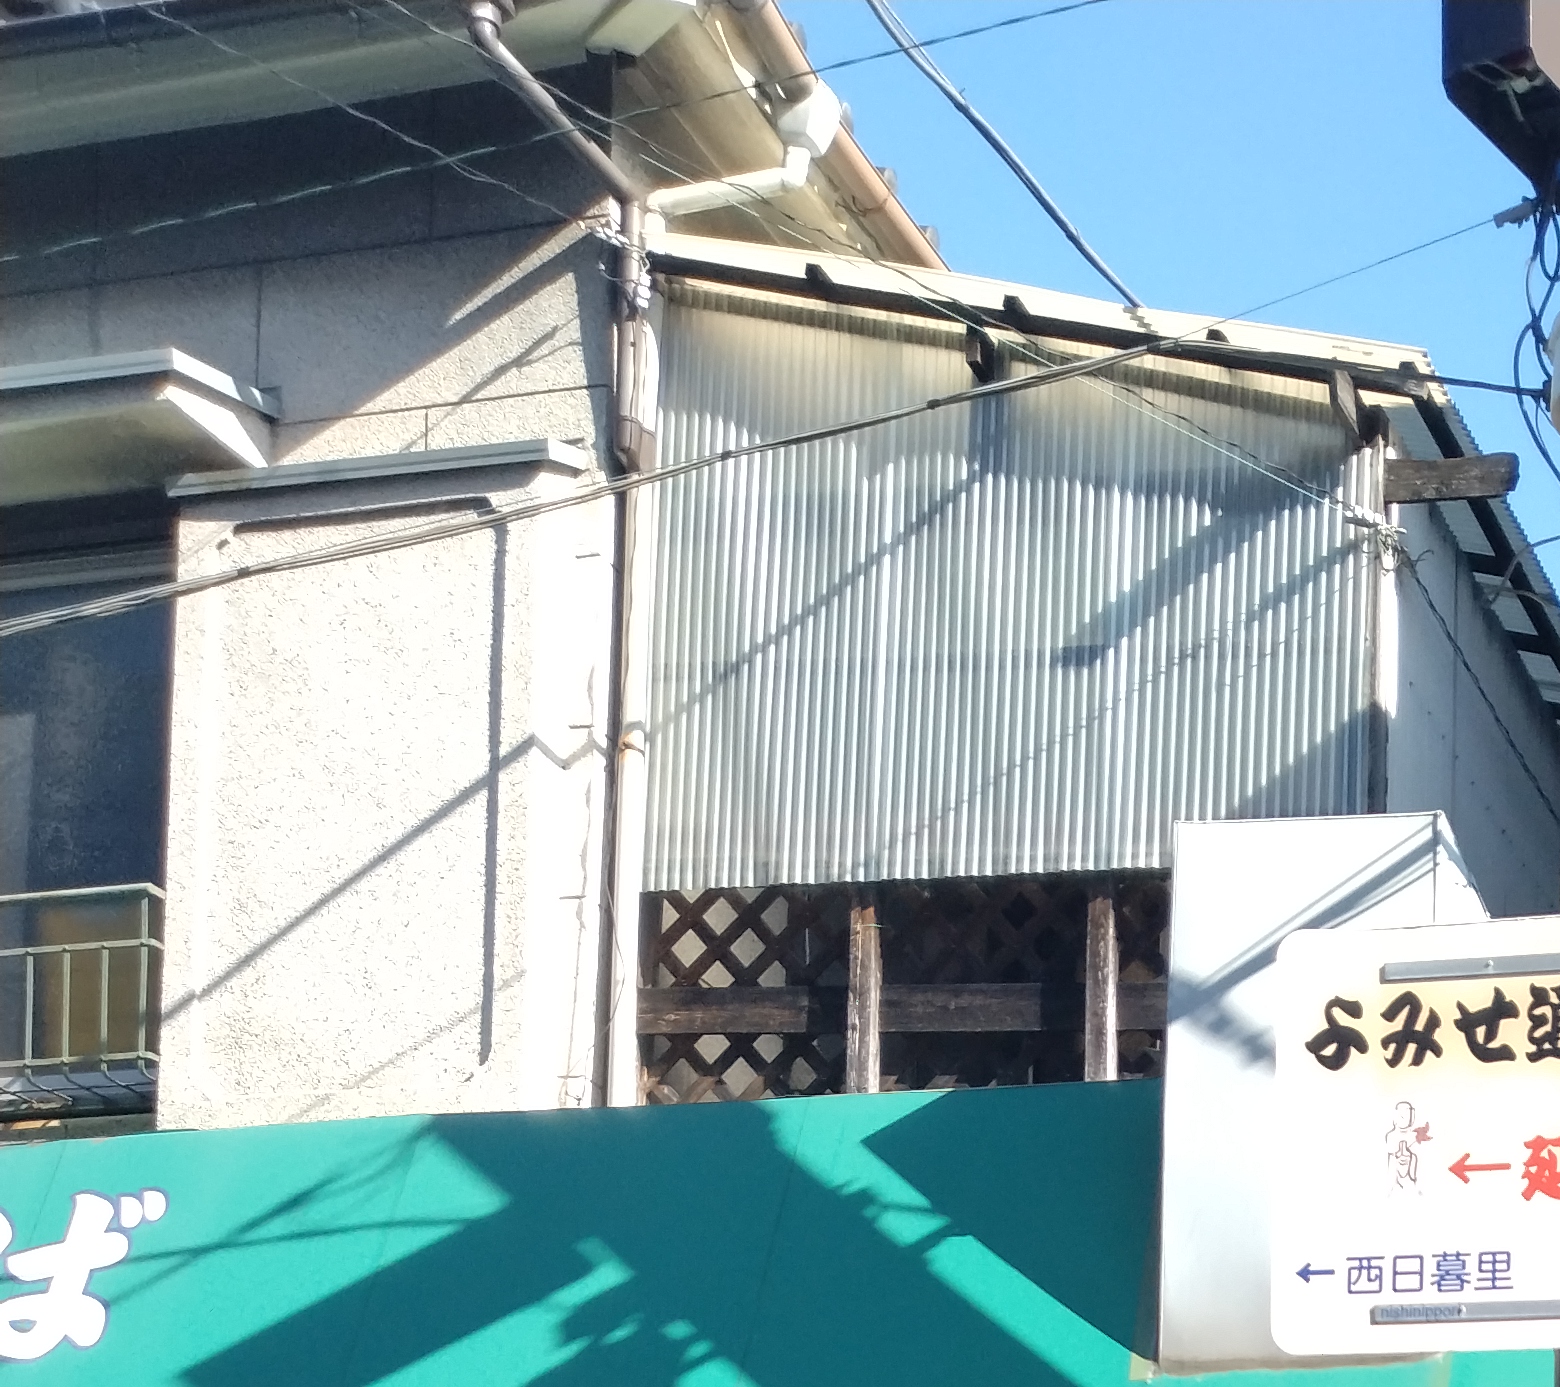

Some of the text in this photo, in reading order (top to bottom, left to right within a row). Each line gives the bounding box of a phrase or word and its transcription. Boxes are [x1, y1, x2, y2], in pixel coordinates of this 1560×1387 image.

[0, 1187, 169, 1362] ば
[1345, 1250, 1514, 1297] 西日暮里
[1380, 1303, 1461, 1322] nishinippor
